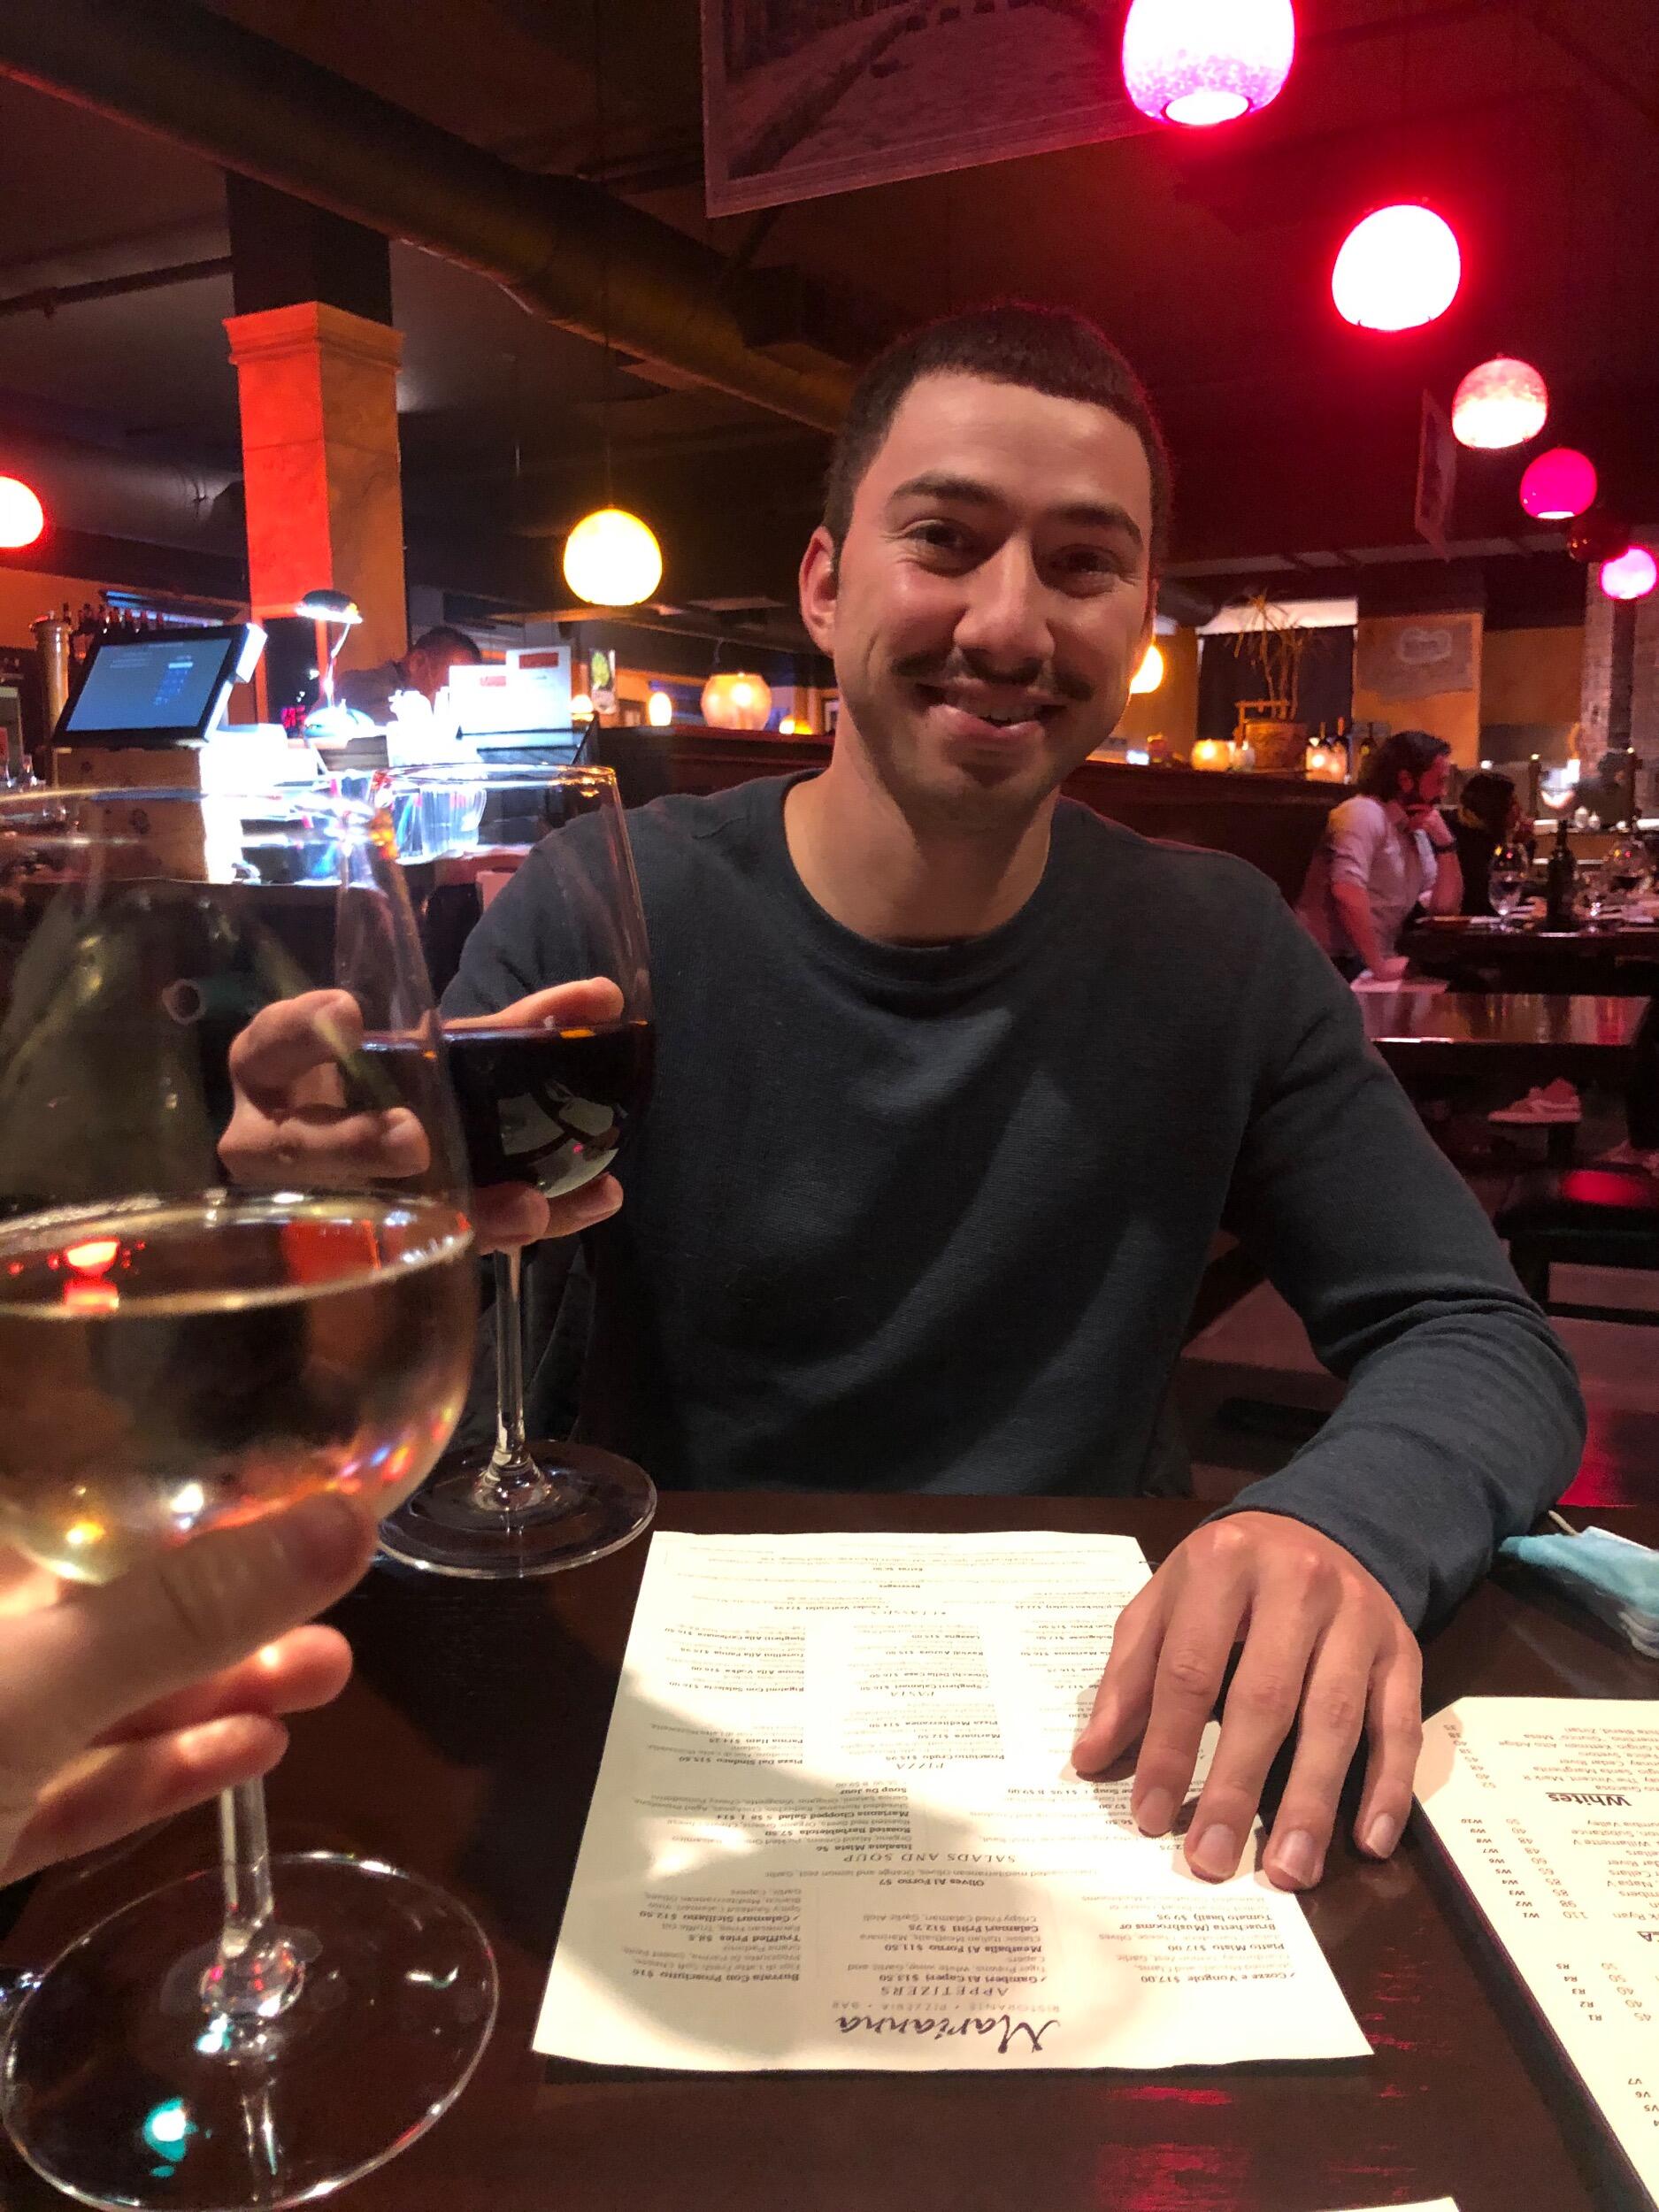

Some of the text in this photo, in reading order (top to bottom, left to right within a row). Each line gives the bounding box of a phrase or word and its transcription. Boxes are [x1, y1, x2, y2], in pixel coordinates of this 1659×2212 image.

[1591, 1759, 1624, 1768] Cedar
[1532, 1766, 1598, 1775] Margherita
[1546, 1793, 1632, 1807] Whites
[843, 1853, 1016, 1863] SALADS AND SOUP
[1618, 1879, 1653, 1888] Napa
[985, 1945, 1042, 1954] Meatballs
[753, 1973, 800, 1982] Burrata
[986, 1975, 1038, 1984] Gamberi
[1188, 1973, 1237, 1983] Vongole
[880, 1985, 1009, 1997] APPETIZERS
[832, 2001, 1060, 2012] RISTORANTE PIZZERIA BAR
[836, 2014, 1060, 2055] Marianna
